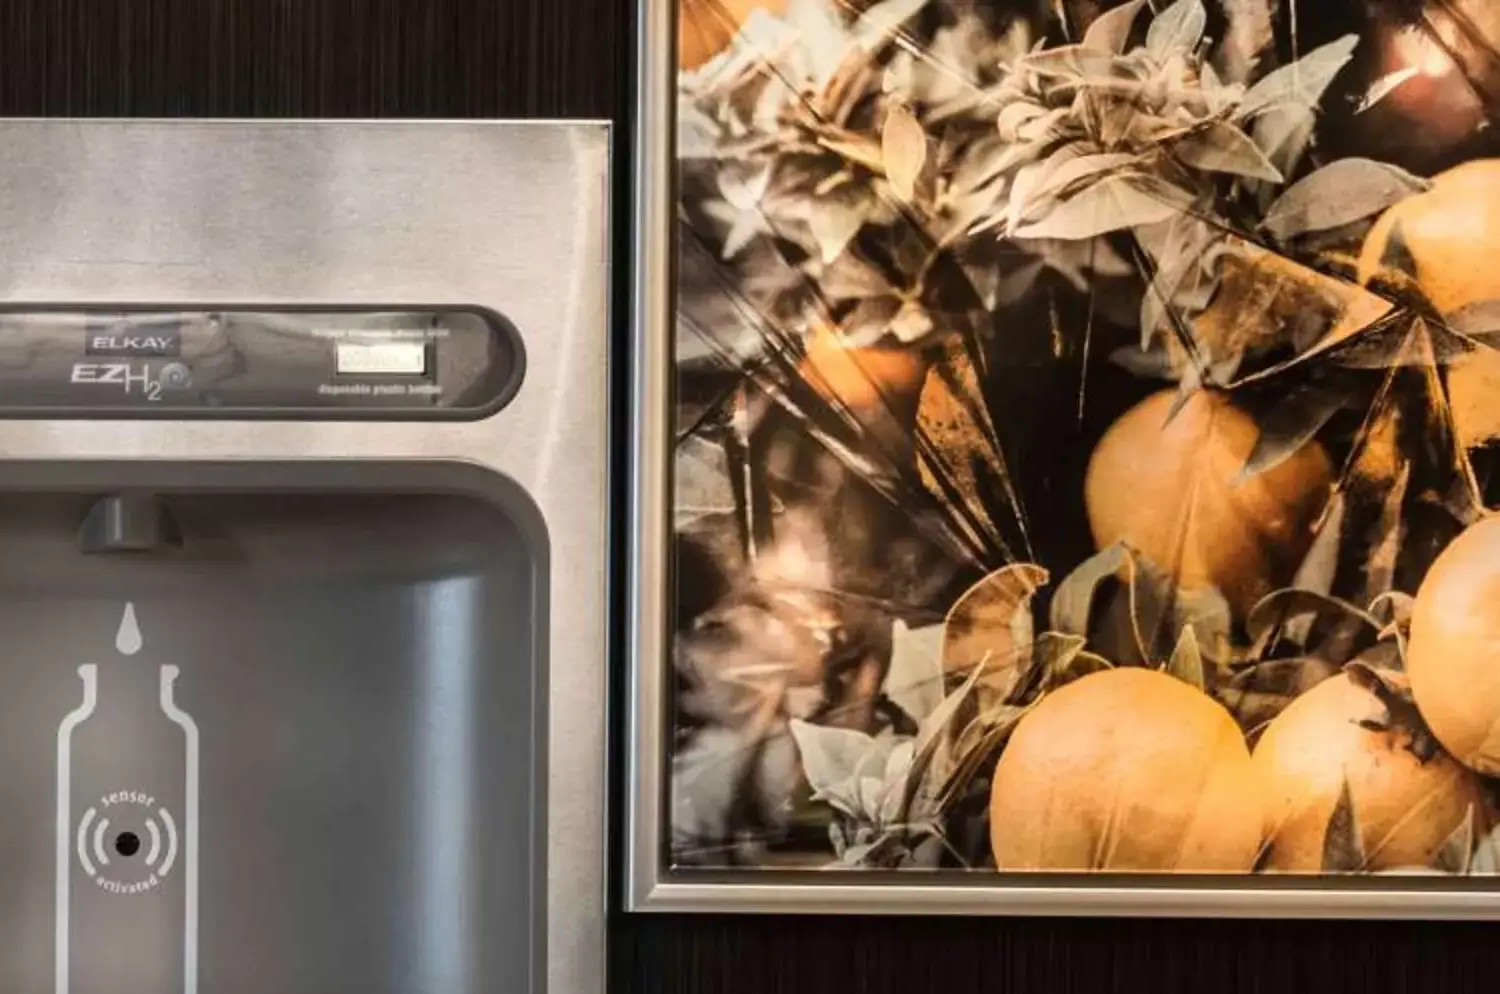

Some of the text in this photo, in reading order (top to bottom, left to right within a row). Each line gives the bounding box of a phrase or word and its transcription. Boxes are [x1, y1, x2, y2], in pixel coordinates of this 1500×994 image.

[93, 336, 172, 349] ELKAY
[101, 790, 155, 808] sensor
[96, 873, 159, 894] activated
